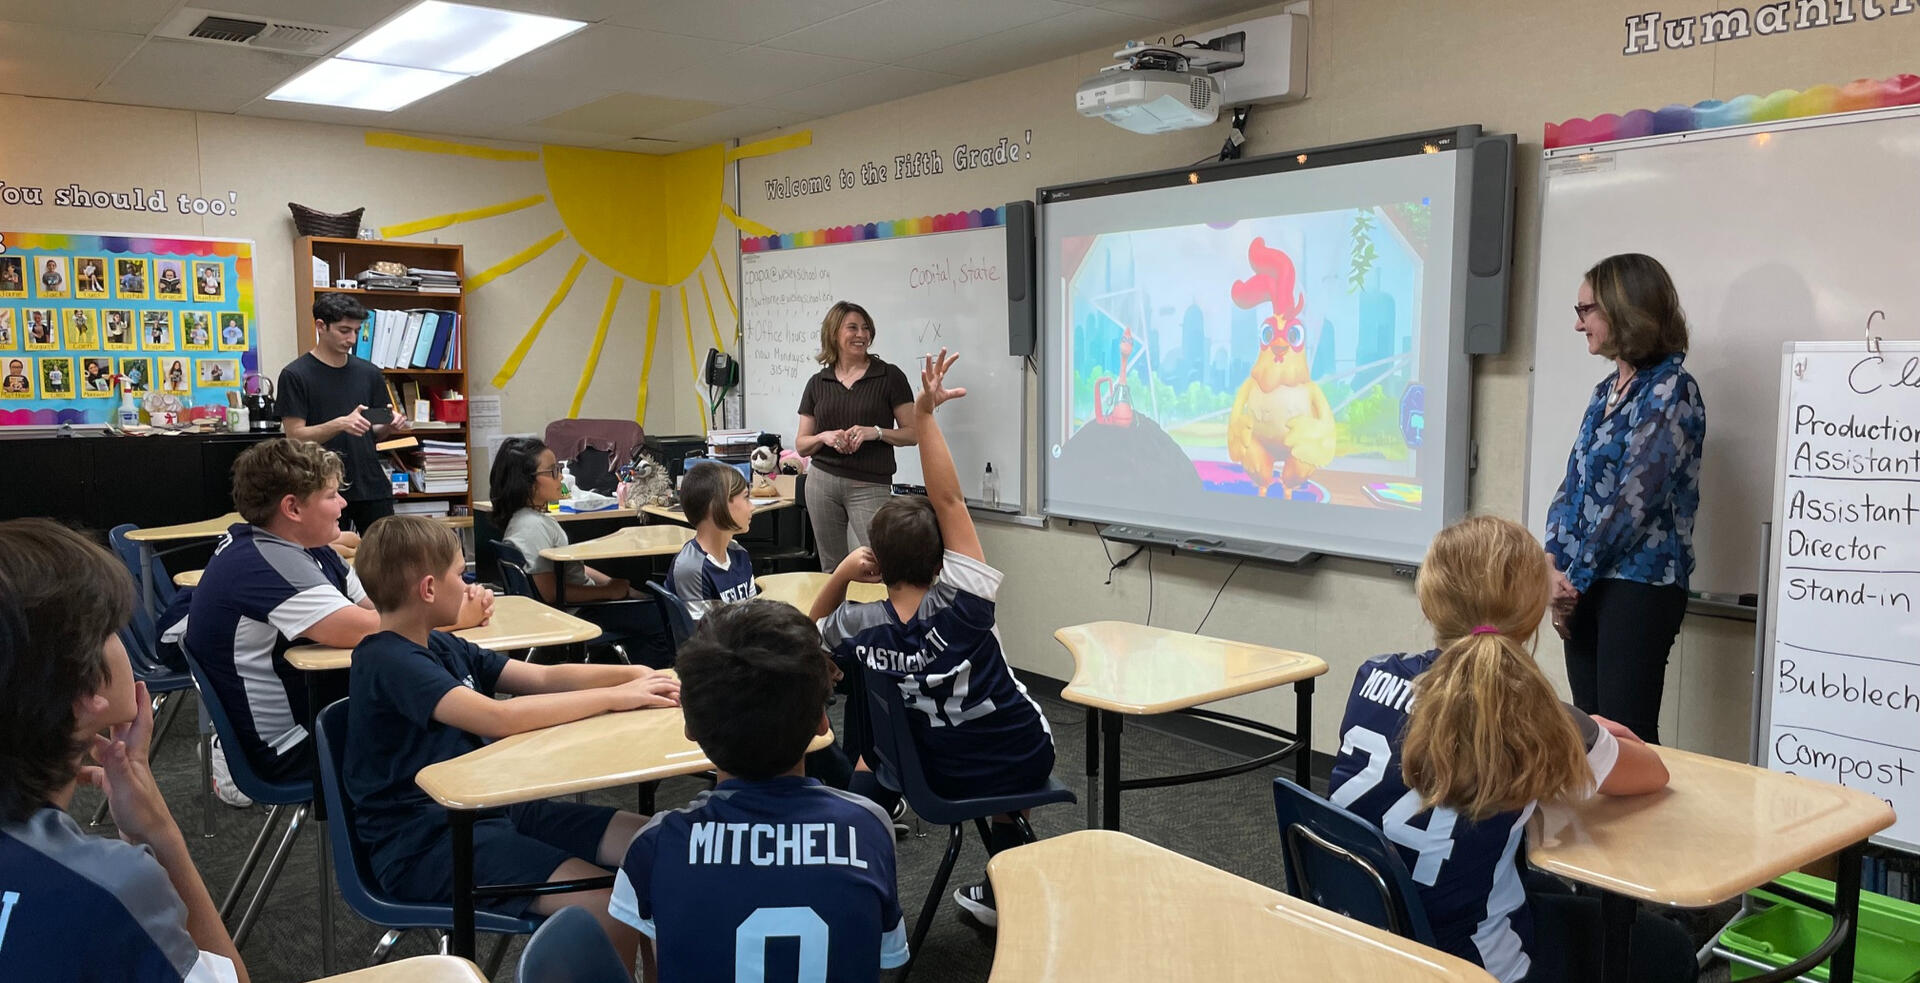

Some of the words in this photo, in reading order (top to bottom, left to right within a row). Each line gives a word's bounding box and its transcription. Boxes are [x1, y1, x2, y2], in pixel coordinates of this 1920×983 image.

[765, 174, 831, 200] Welcome
[839, 168, 855, 189] to
[861, 162, 887, 185] the
[894, 150, 943, 179] Fifth
[55, 184, 168, 212] should
[178, 191, 238, 216] too!
[755, 320, 783, 342] Office
[1794, 441, 1920, 474] Assistant
[1789, 490, 1919, 525] Assistant
[1788, 529, 1886, 561] Director
[1787, 578, 1910, 612] Stand-in
[897, 659, 997, 727] 42
[1776, 733, 1914, 786] Compost
[1329, 725, 1458, 886] 24
[689, 821, 868, 869] MITCHELL
